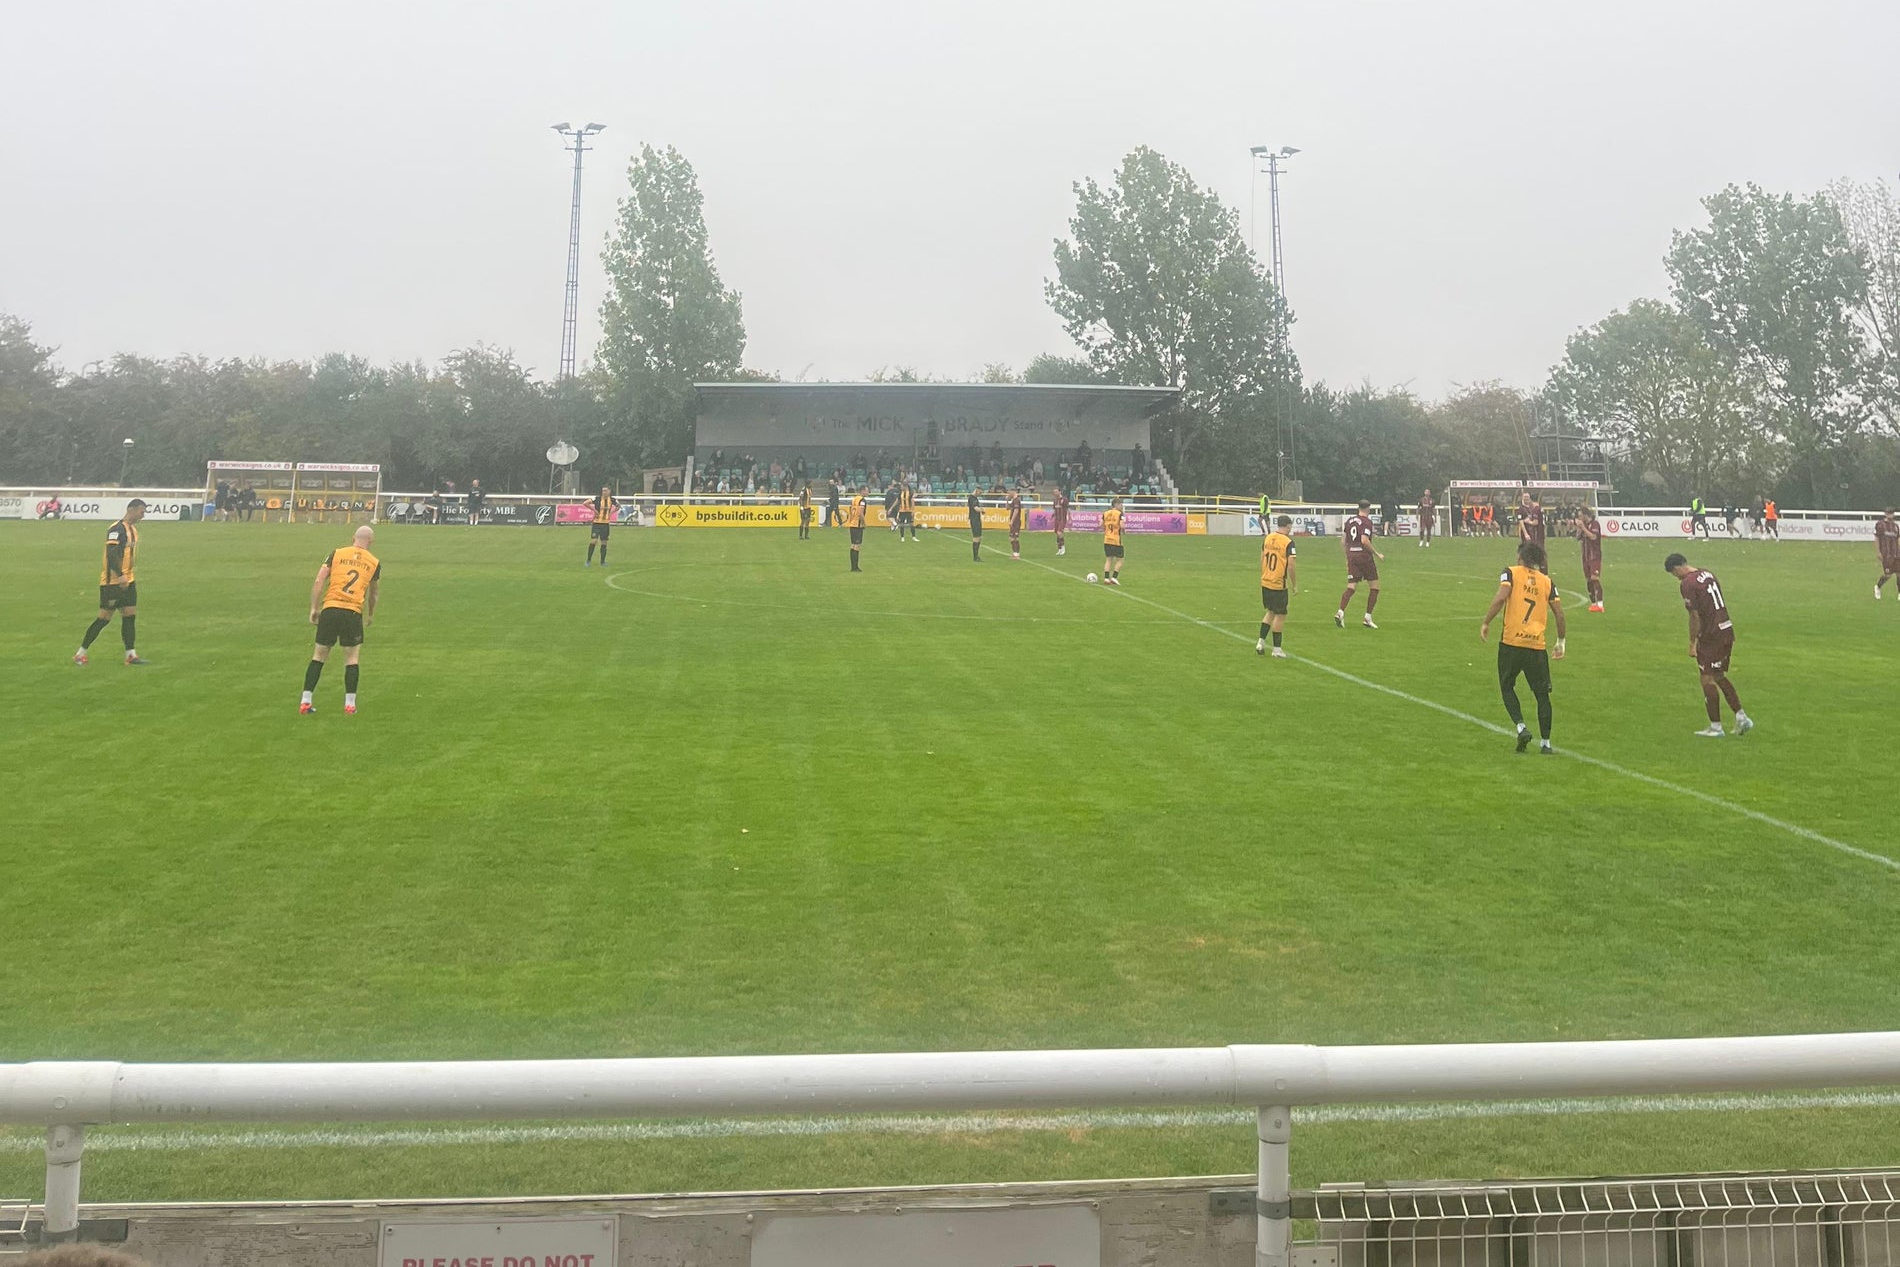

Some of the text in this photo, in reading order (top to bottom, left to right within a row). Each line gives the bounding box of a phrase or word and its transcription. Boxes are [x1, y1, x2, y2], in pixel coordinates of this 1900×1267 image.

[857, 416, 904, 432] MICK
[945, 417, 1009, 433] BRADY
[1014, 419, 1043, 431] Stand
[219, 462, 281, 470] warwicksigns.co.uk
[307, 464, 369, 472] warwicksigns.co.uk
[61, 503, 100, 513] ALOR
[696, 511, 788, 522] bpsbuildit.co.uk
[1621, 522, 1659, 531] CALOR
[1778, 524, 1813, 534] hildcare
[1350, 526, 1357, 541] 9
[1265, 552, 1277, 572] 10
[342, 570, 360, 594] 2
[1707, 581, 1724, 610] 11
[1522, 597, 1537, 624] 7
